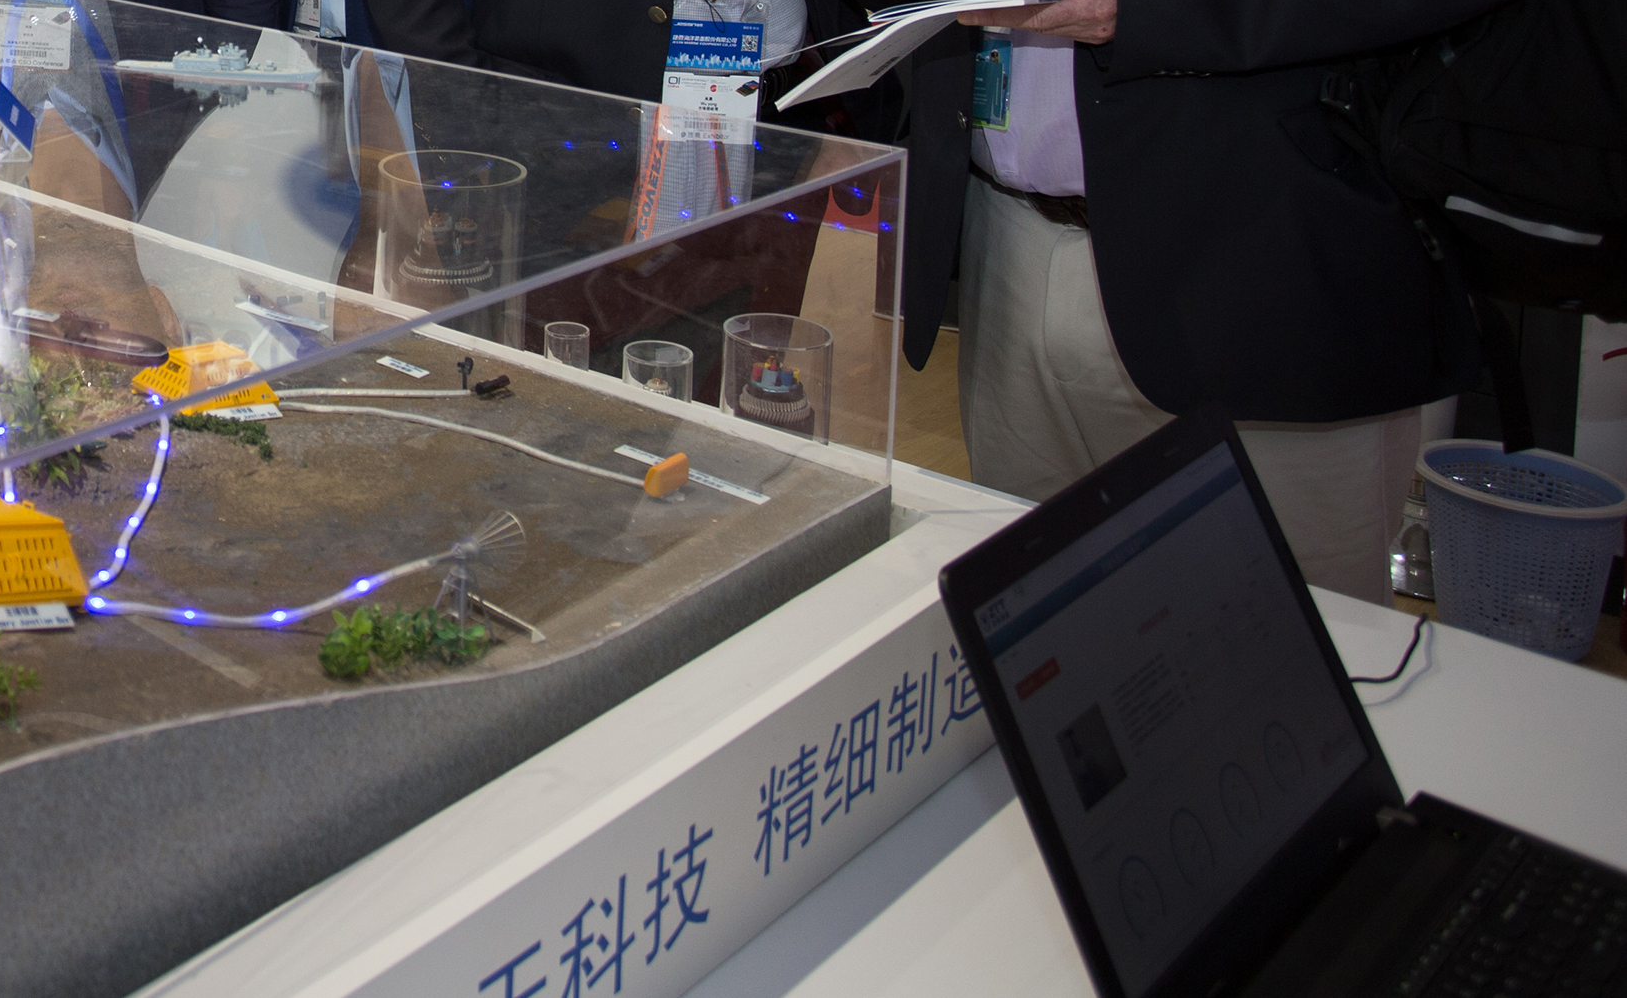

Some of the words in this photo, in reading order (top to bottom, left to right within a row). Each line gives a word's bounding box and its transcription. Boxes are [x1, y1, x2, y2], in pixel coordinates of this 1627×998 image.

[33, 59, 64, 67] Conference
[703, 132, 730, 140] Exhibitor
[754, 643, 985, 877] 精细制造
